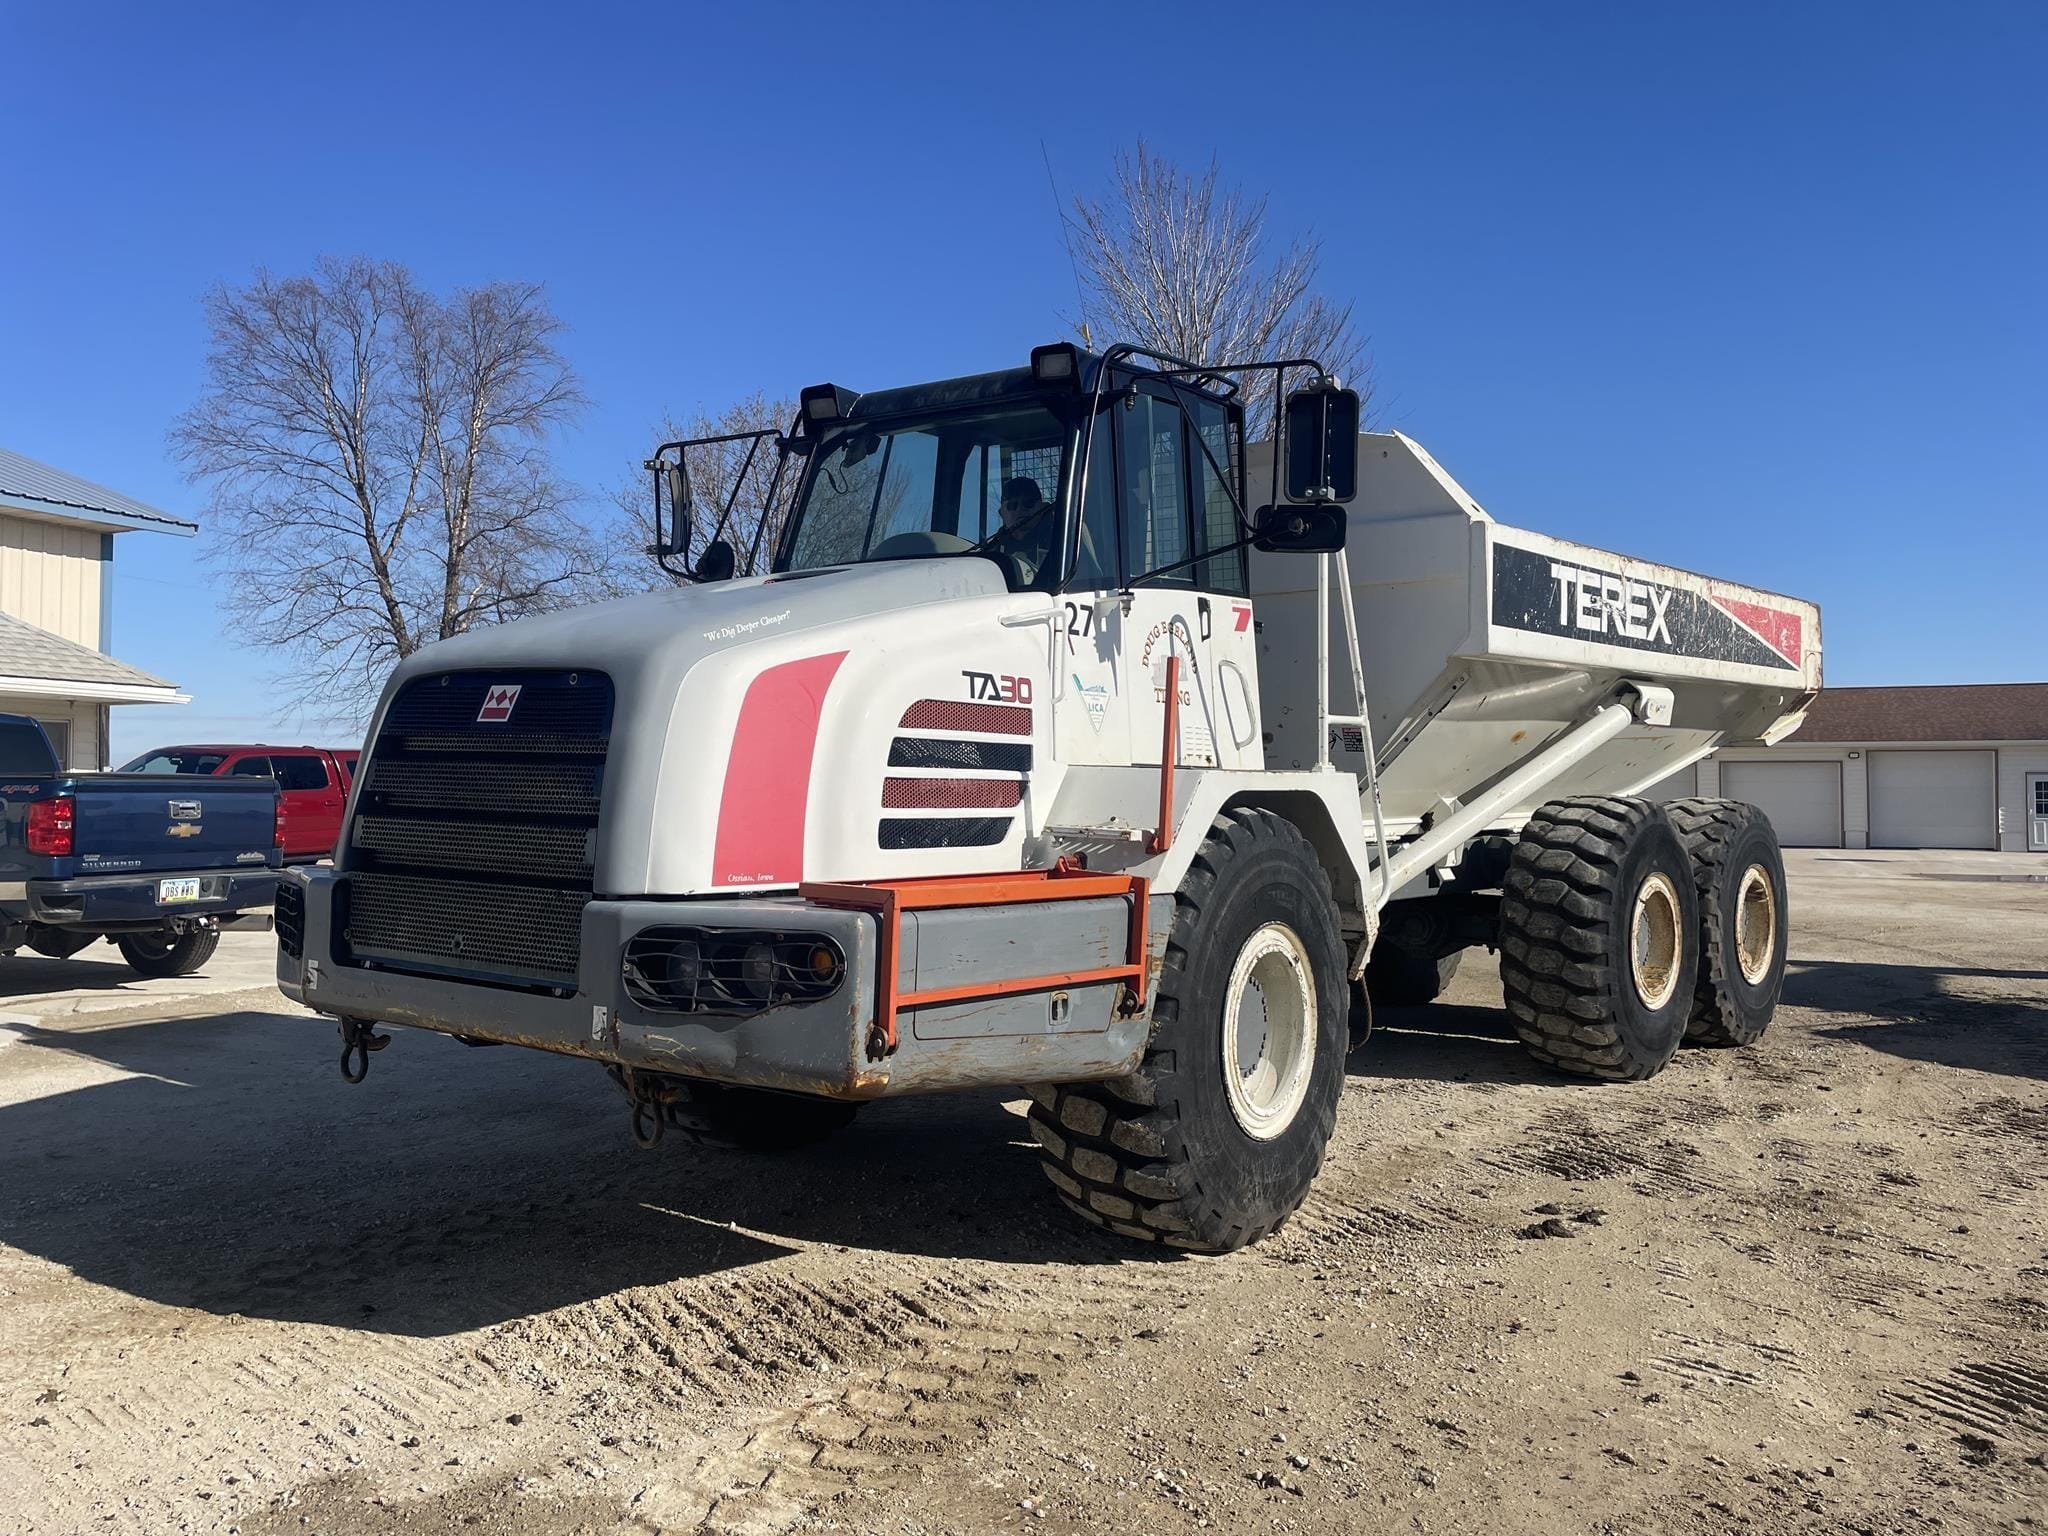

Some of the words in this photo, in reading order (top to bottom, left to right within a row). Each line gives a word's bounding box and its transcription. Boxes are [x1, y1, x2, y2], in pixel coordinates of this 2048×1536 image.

[1551, 562, 1672, 645] TEREX
[721, 627, 736, 639] Dig
[736, 620, 759, 633] Deeper
[1065, 601, 1093, 637] 27
[1232, 606, 1251, 632] 7
[1142, 625, 1160, 668] DOUG
[962, 670, 1032, 704] TA30
[1088, 703, 1104, 712] LICA
[81, 860, 141, 869] SILVERADO
